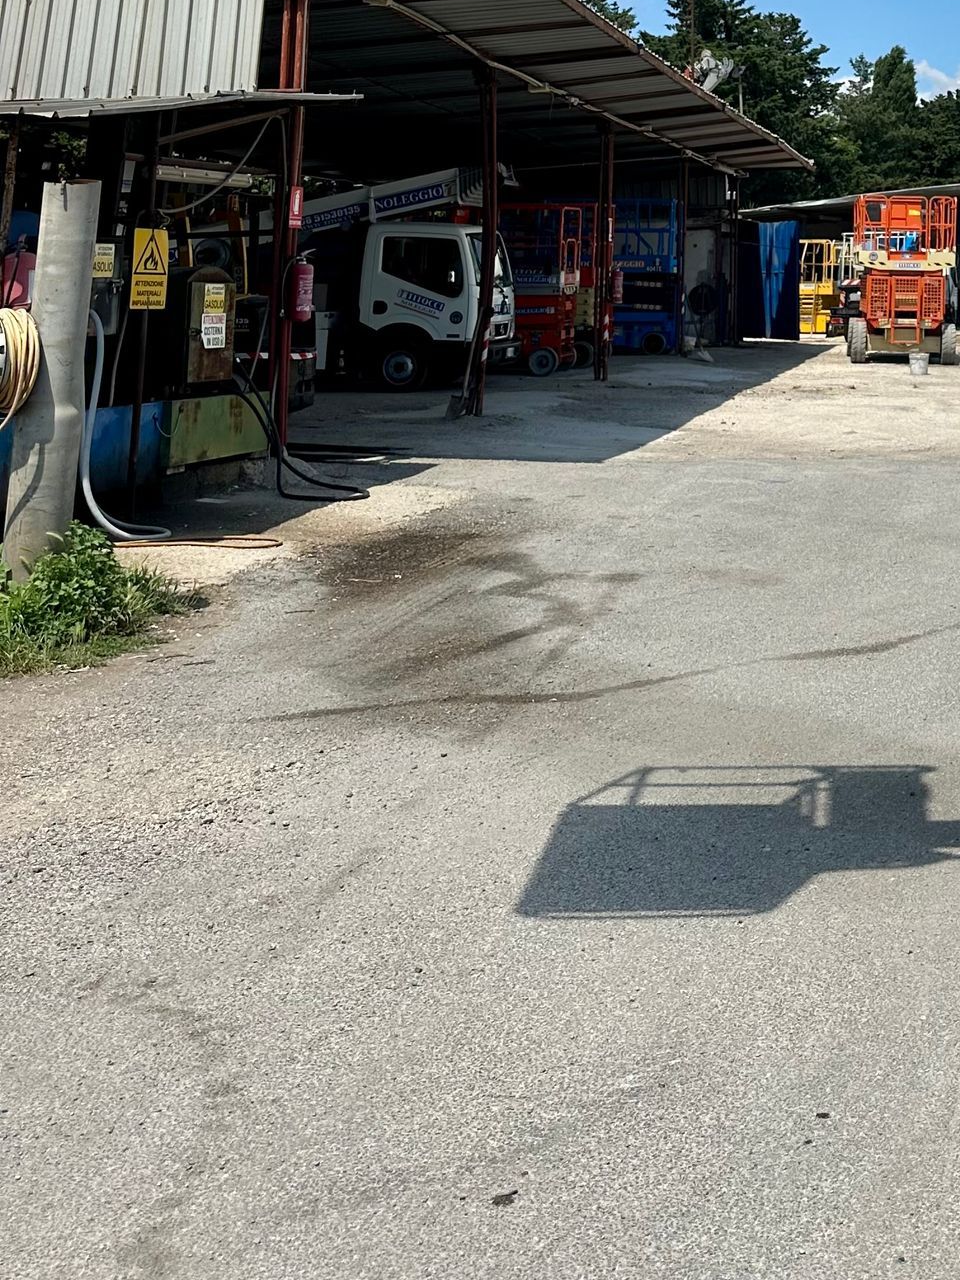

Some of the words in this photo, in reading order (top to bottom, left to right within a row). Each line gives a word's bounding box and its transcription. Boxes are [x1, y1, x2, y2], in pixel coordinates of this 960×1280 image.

[375, 185, 443, 210] NOLEGGIO
[313, 205, 361, 222] 51530135
[93, 260, 113, 272] ASOLIO
[205, 300, 224, 309] GASOLIO
[203, 326, 223, 335] CISTERNA
